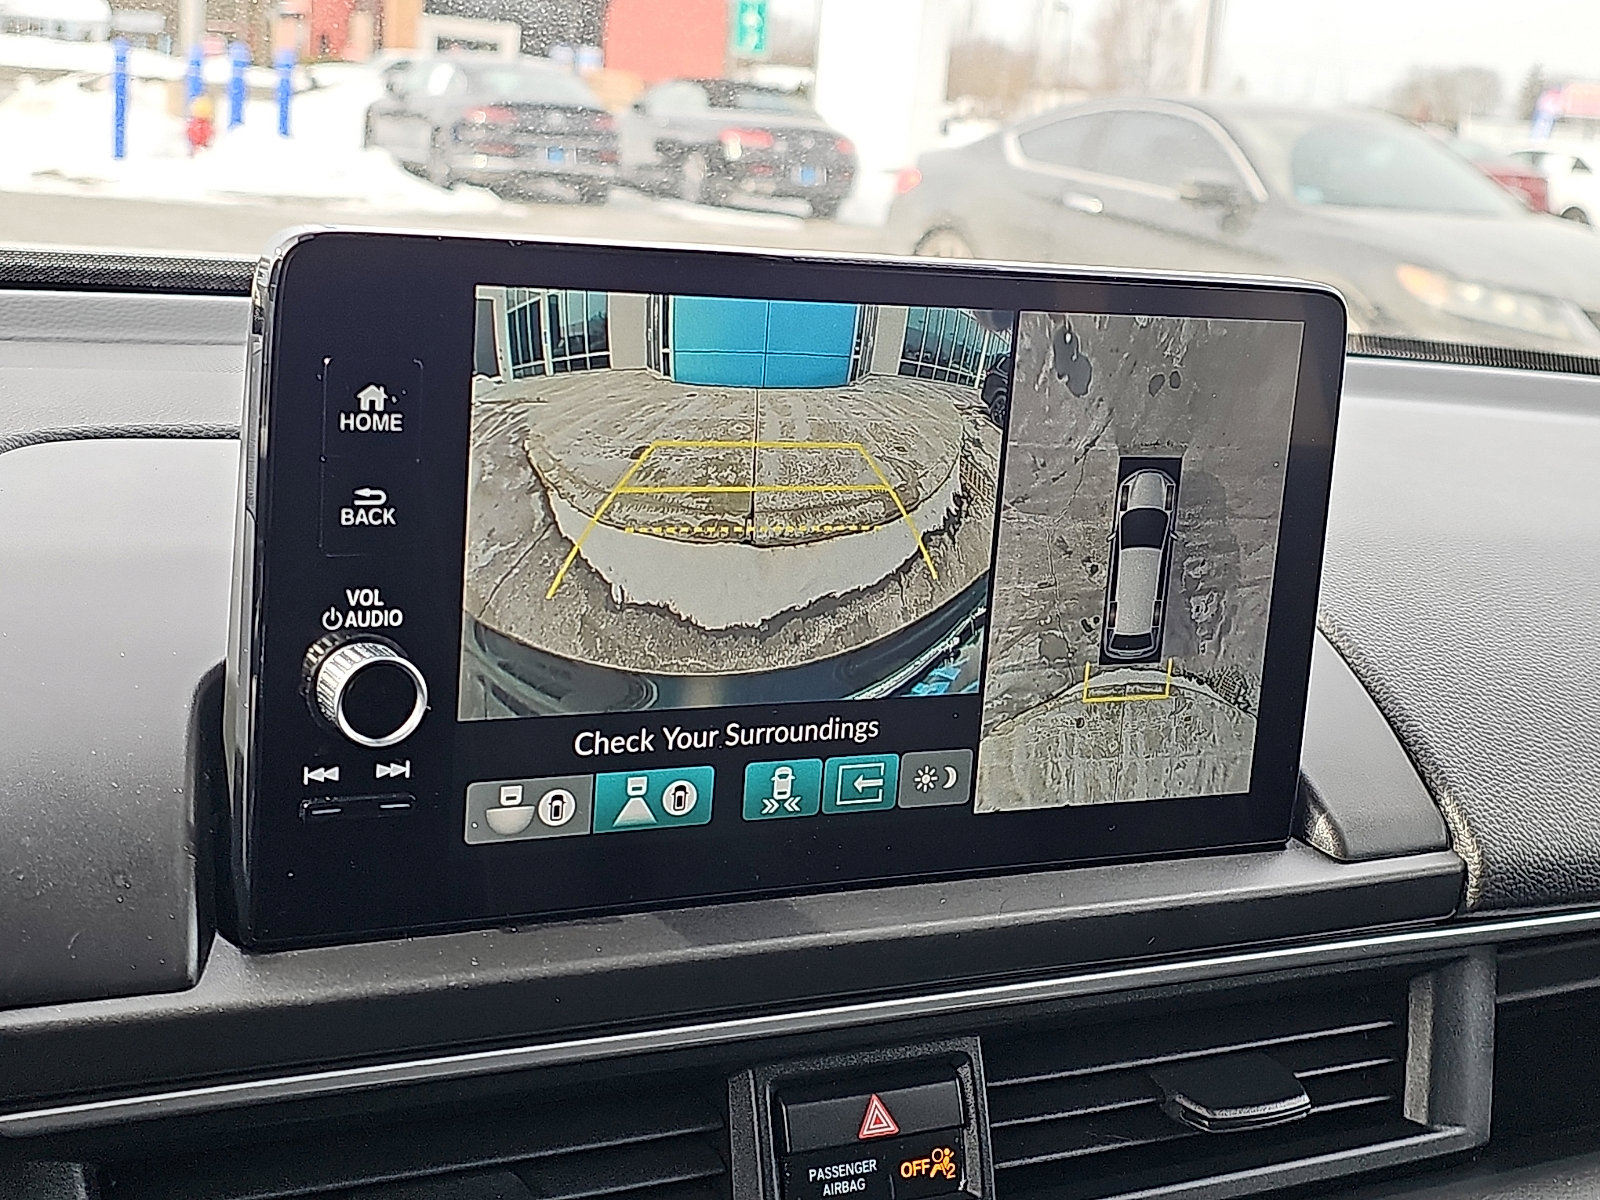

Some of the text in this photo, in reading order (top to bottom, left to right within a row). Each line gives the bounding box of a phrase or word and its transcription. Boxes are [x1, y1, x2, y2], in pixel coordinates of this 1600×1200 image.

[339, 413, 403, 432] HOME
[340, 508, 397, 526] BACK
[346, 589, 385, 606] VOL
[344, 609, 404, 628] AUDIO
[574, 717, 880, 757] Check Your Surroundings
[808, 1159, 878, 1182] PASSENGER
[900, 1158, 931, 1178] OFF
[822, 1177, 866, 1197] AIRBAG
